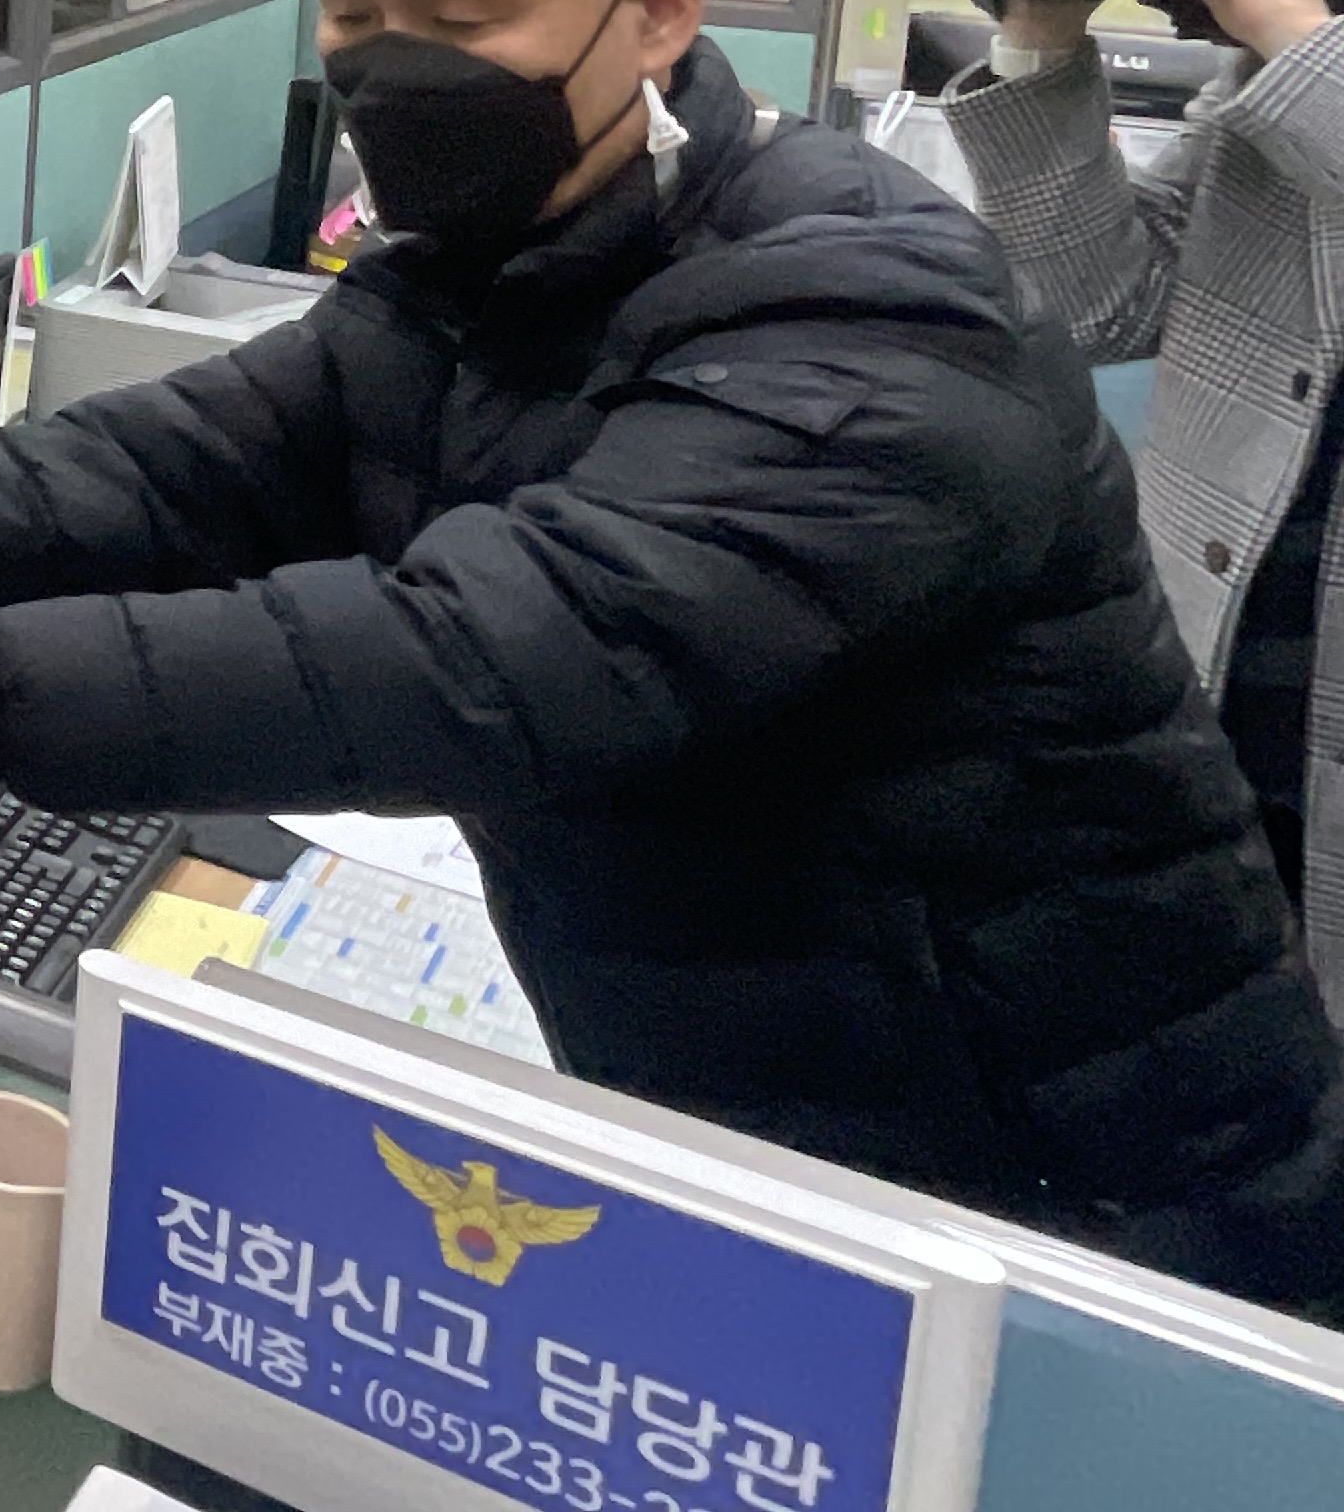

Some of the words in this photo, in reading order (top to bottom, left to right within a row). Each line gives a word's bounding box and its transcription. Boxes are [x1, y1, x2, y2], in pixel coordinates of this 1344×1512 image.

[1113, 54, 1150, 70] LG
[153, 1280, 309, 1388] 부재중
[364, 1378, 709, 1512] (055)233-
[156, 1186, 490, 1389] 집회신고
[536, 1337, 834, 1512] 담당관
